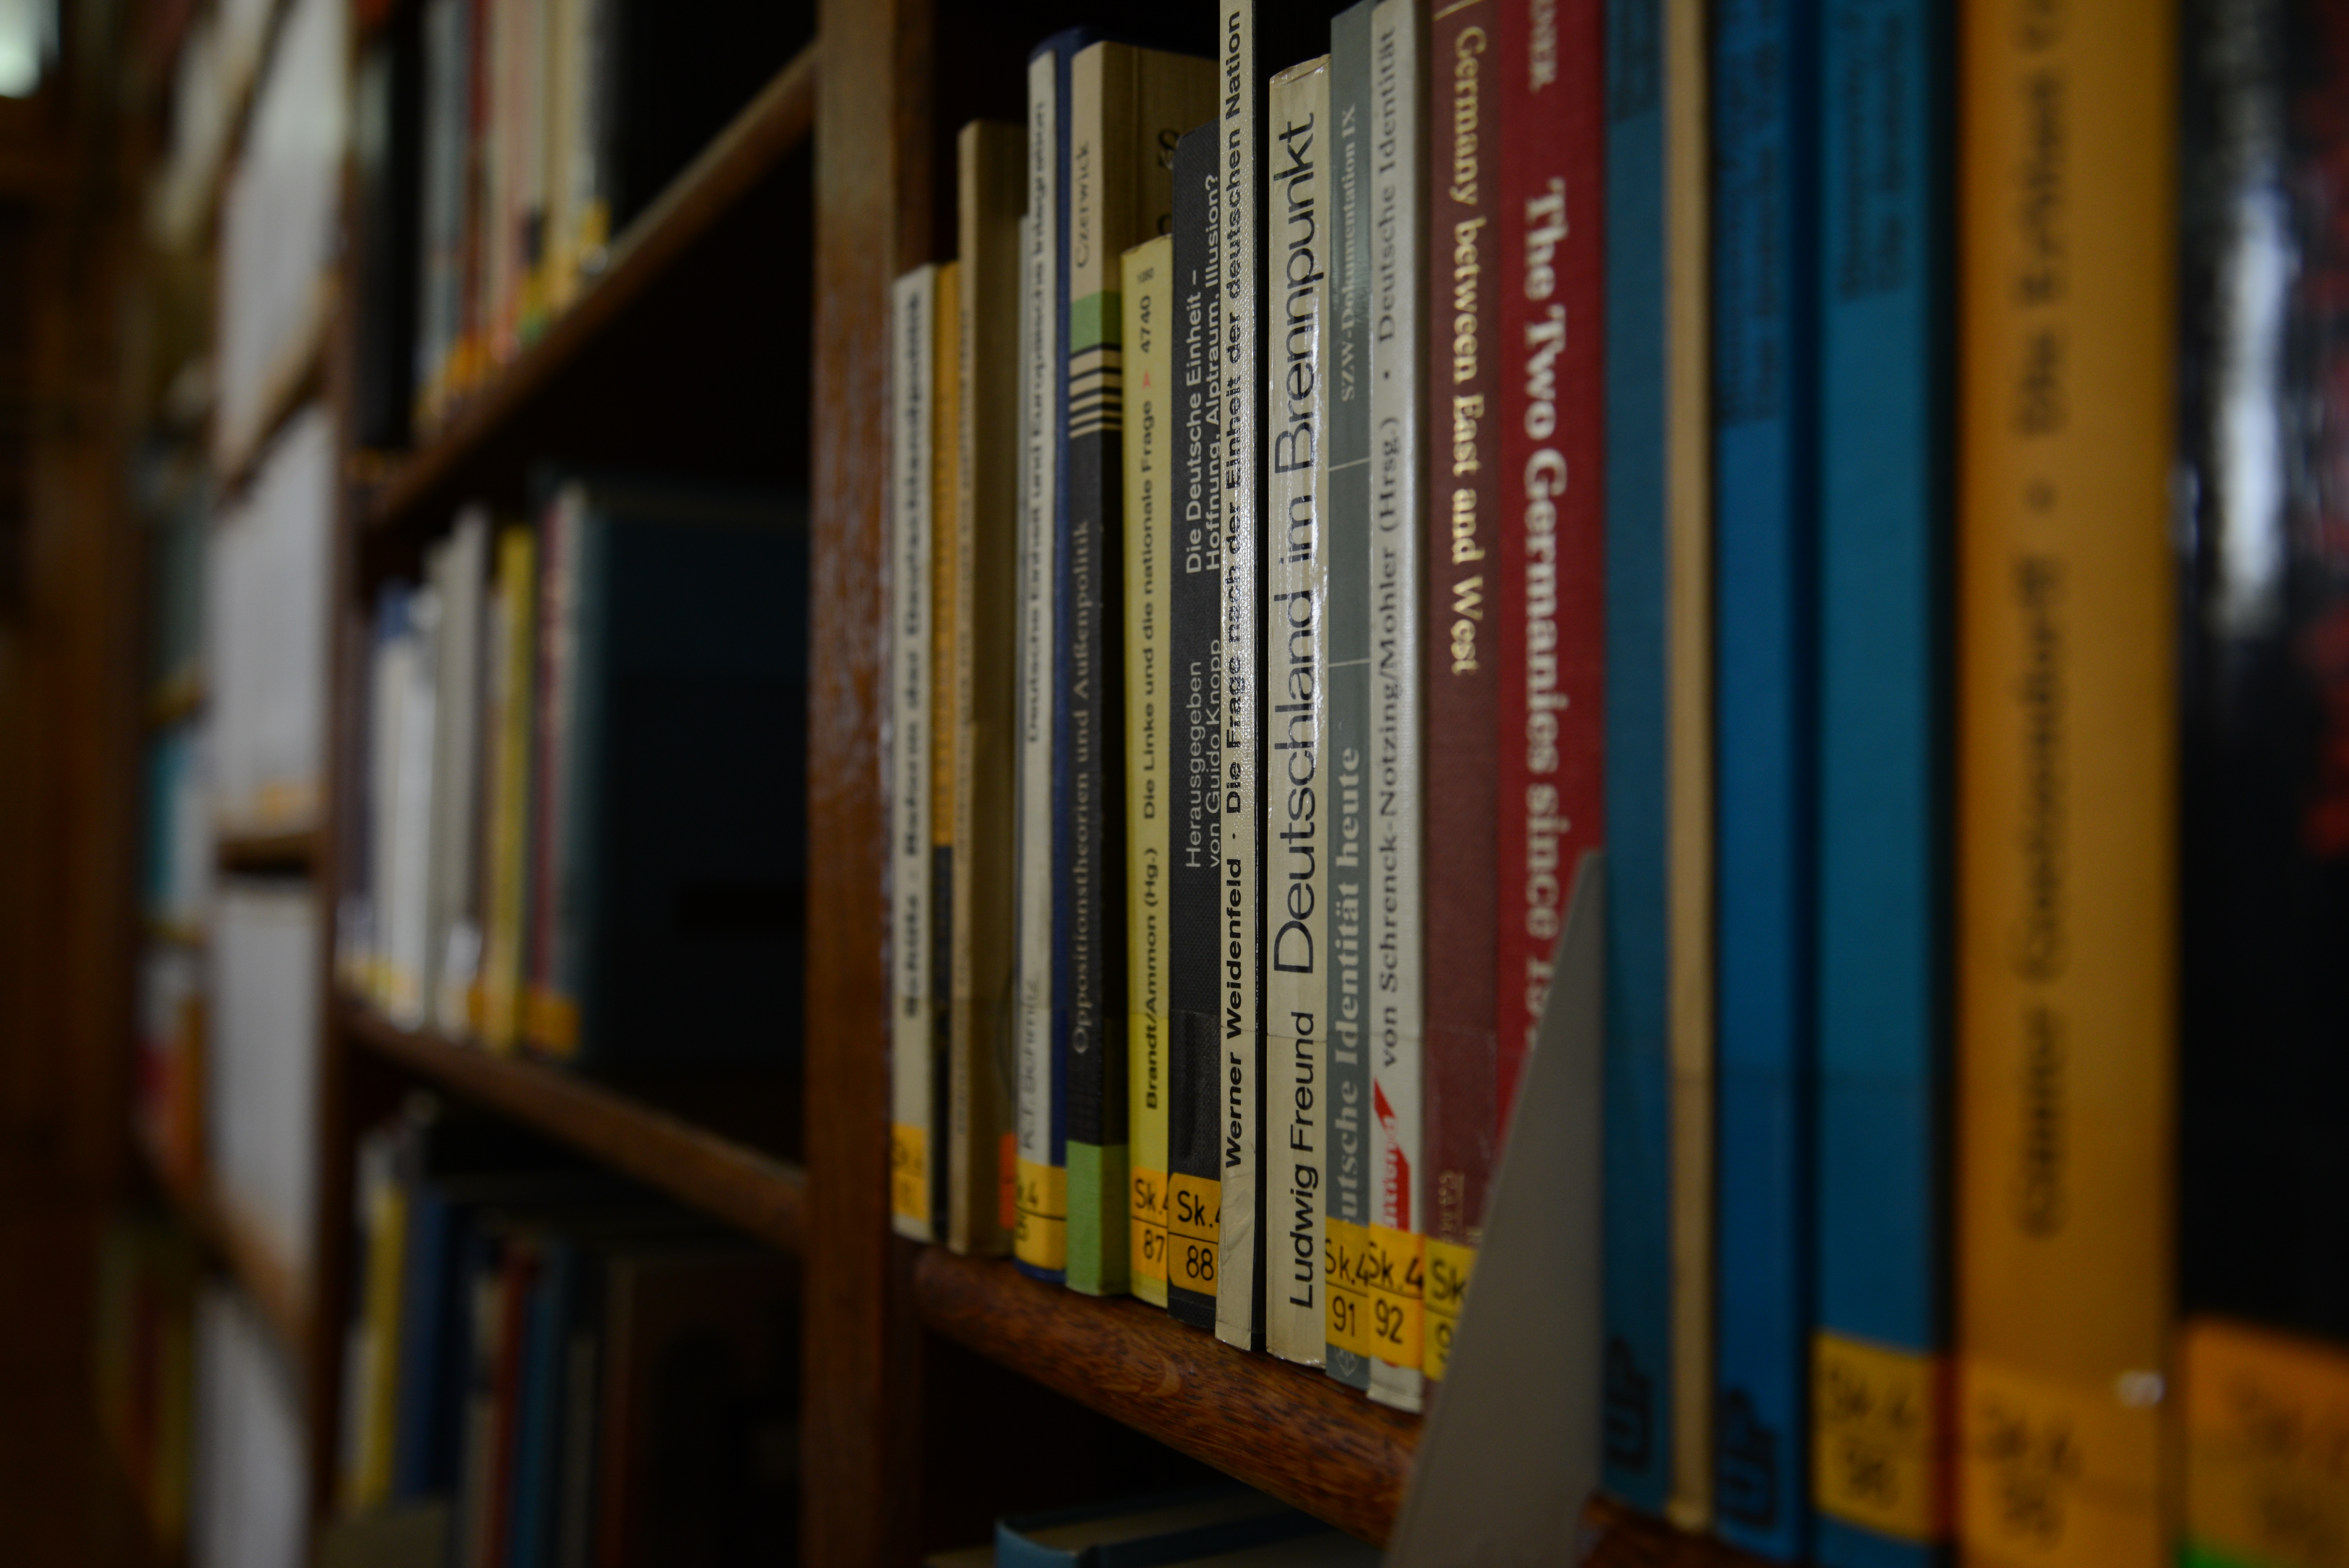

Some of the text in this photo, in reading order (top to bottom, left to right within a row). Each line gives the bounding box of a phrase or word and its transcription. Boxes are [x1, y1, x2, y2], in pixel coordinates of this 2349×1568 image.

[1074, 141, 1090, 269] Czerwick
[1205, 174, 1219, 288] Illusion?
[1339, 103, 1357, 402] SZW-Dokumentation IX
[1523, 176, 1569, 302] The
[1139, 295, 1152, 353] 4740
[1186, 291, 1202, 386] Einheit
[1449, 26, 1487, 676] Germany between East and West
[1523, 304, 1567, 442] Two
[1140, 401, 1155, 472] Frage
[1185, 393, 1202, 521] Deutsche
[1141, 479, 1154, 595] nationale
[1185, 526, 1202, 574] Die
[1225, 11, 1245, 1168] Werner Weidenfeld Die Frage nach der Einheit der deutschen Nation
[1273, 112, 1323, 974] Deutschland im Brennpunkt
[1378, 25, 1400, 1067] von Schrenck-Notzing/Mohler (Hrsg.) Deutsche Identität
[1142, 602, 1154, 640] die
[1142, 646, 1155, 695] und
[1522, 448, 1570, 775] Germanies
[1071, 520, 1094, 1054] Oppositionstheorien und Außenpolitik
[1143, 704, 1155, 771] Linke
[1143, 780, 1155, 819] Die
[1185, 661, 1206, 868] Herausgegeben
[1205, 639, 1221, 868] von Guido Knopp
[1336, 746, 1359, 866] heute
[1524, 783, 1571, 939] since
[1143, 847, 1158, 907] (Hg.)
[1144, 914, 1159, 1110] Brandt/Ammon
[1335, 882, 1360, 1066] Identität
[1289, 1011, 1318, 1308] Ludwig Freund
[1143, 1229, 1165, 1263] 87
[1186, 1245, 1214, 1281] 88
[1333, 1296, 1355, 1338] 91
[1375, 1299, 1404, 1344] 92
